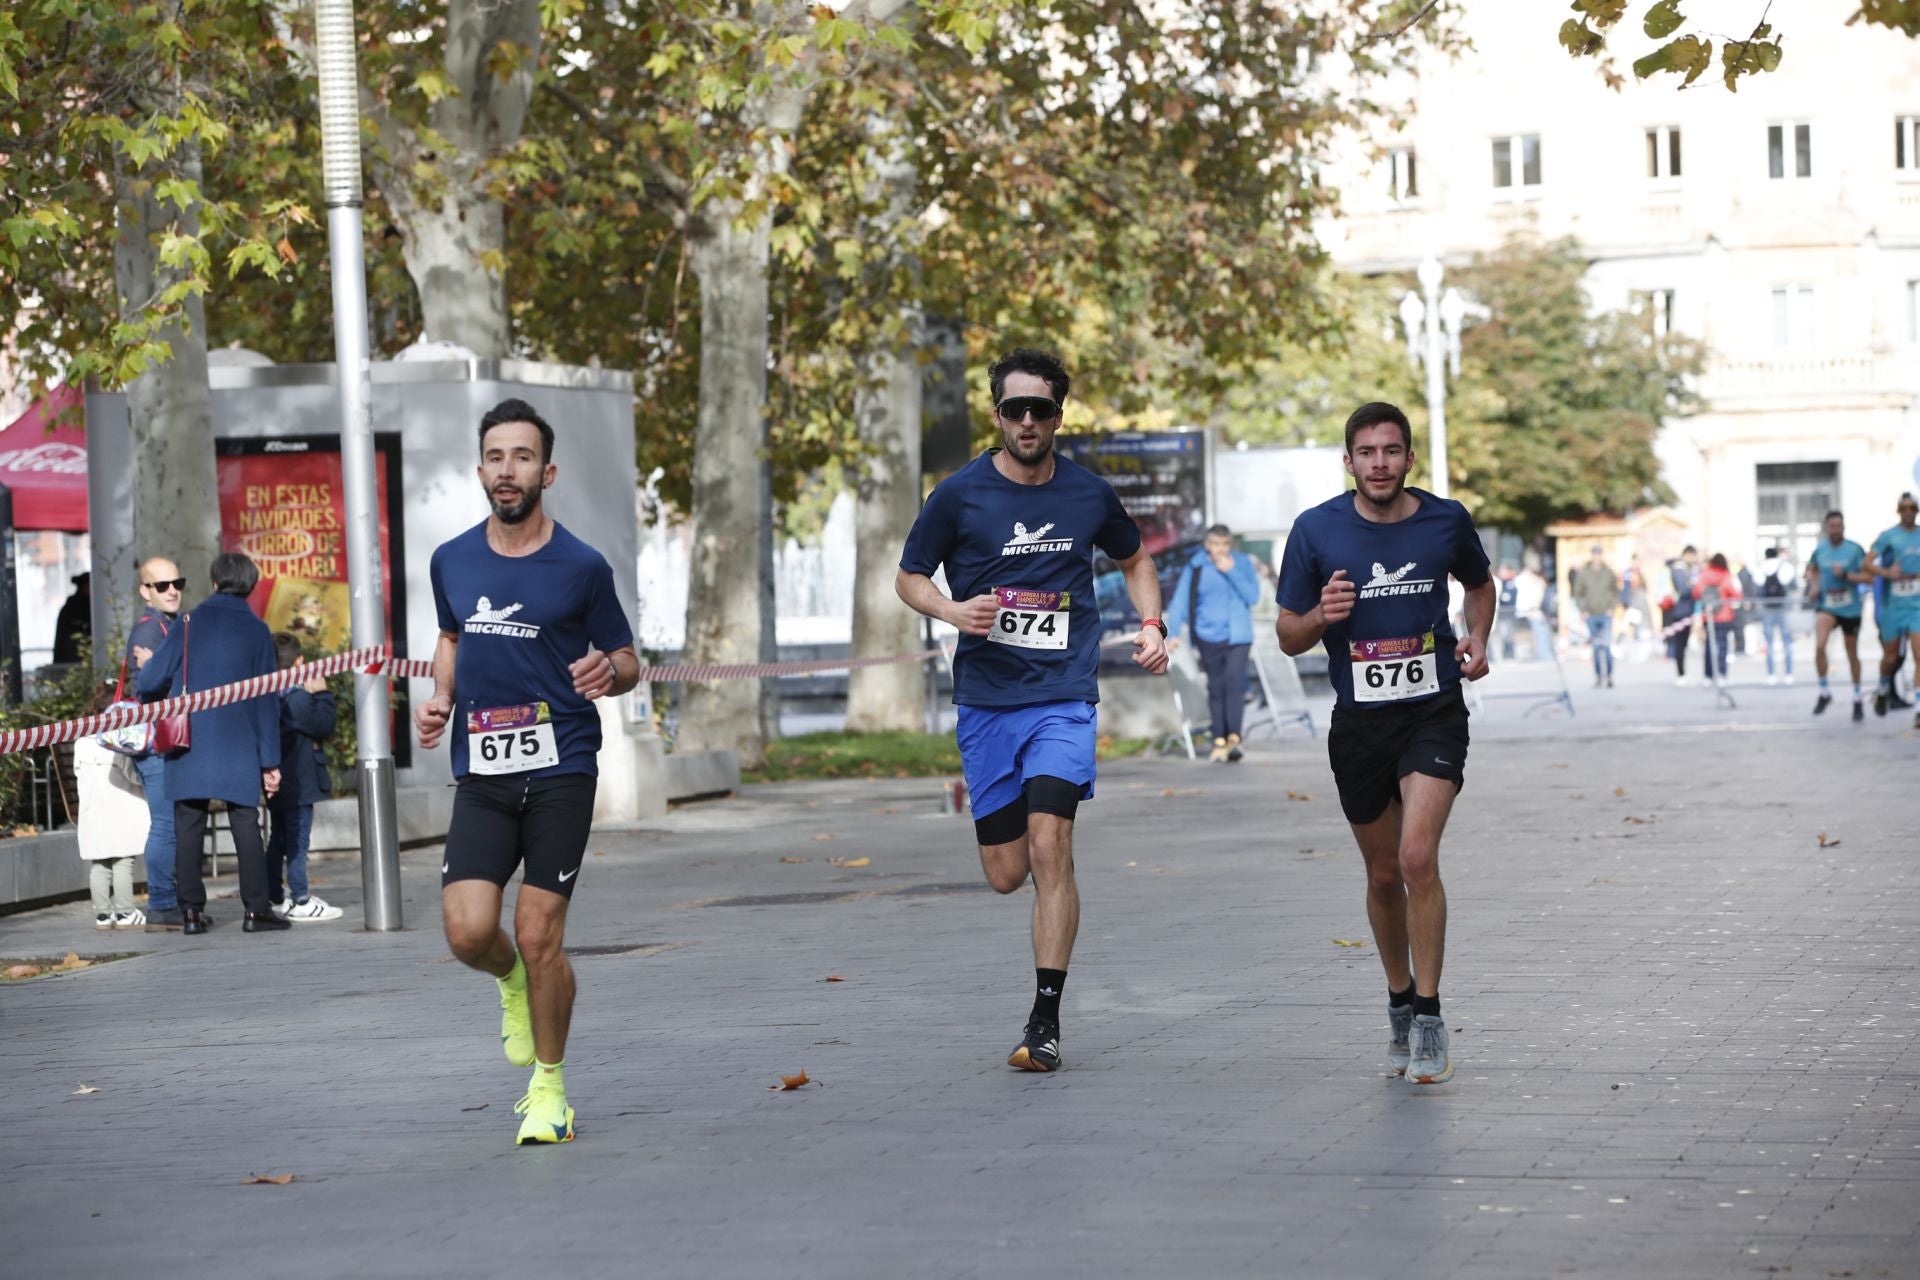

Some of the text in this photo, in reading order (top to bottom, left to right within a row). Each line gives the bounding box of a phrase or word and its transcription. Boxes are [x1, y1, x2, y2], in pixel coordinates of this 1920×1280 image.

[246, 484, 331, 507] EN ESTAS
[240, 507, 341, 531] NAVIDADES.
[317, 532, 340, 554] DE
[1001, 542, 1073, 556] MICHELIN
[1360, 583, 1434, 599] MICHELIN
[464, 623, 539, 639] MICHELIN
[1000, 611, 1056, 637] 674
[1378, 645, 1409, 653] EMPRESAS
[1365, 660, 1424, 688] 676
[481, 730, 540, 761] 675
